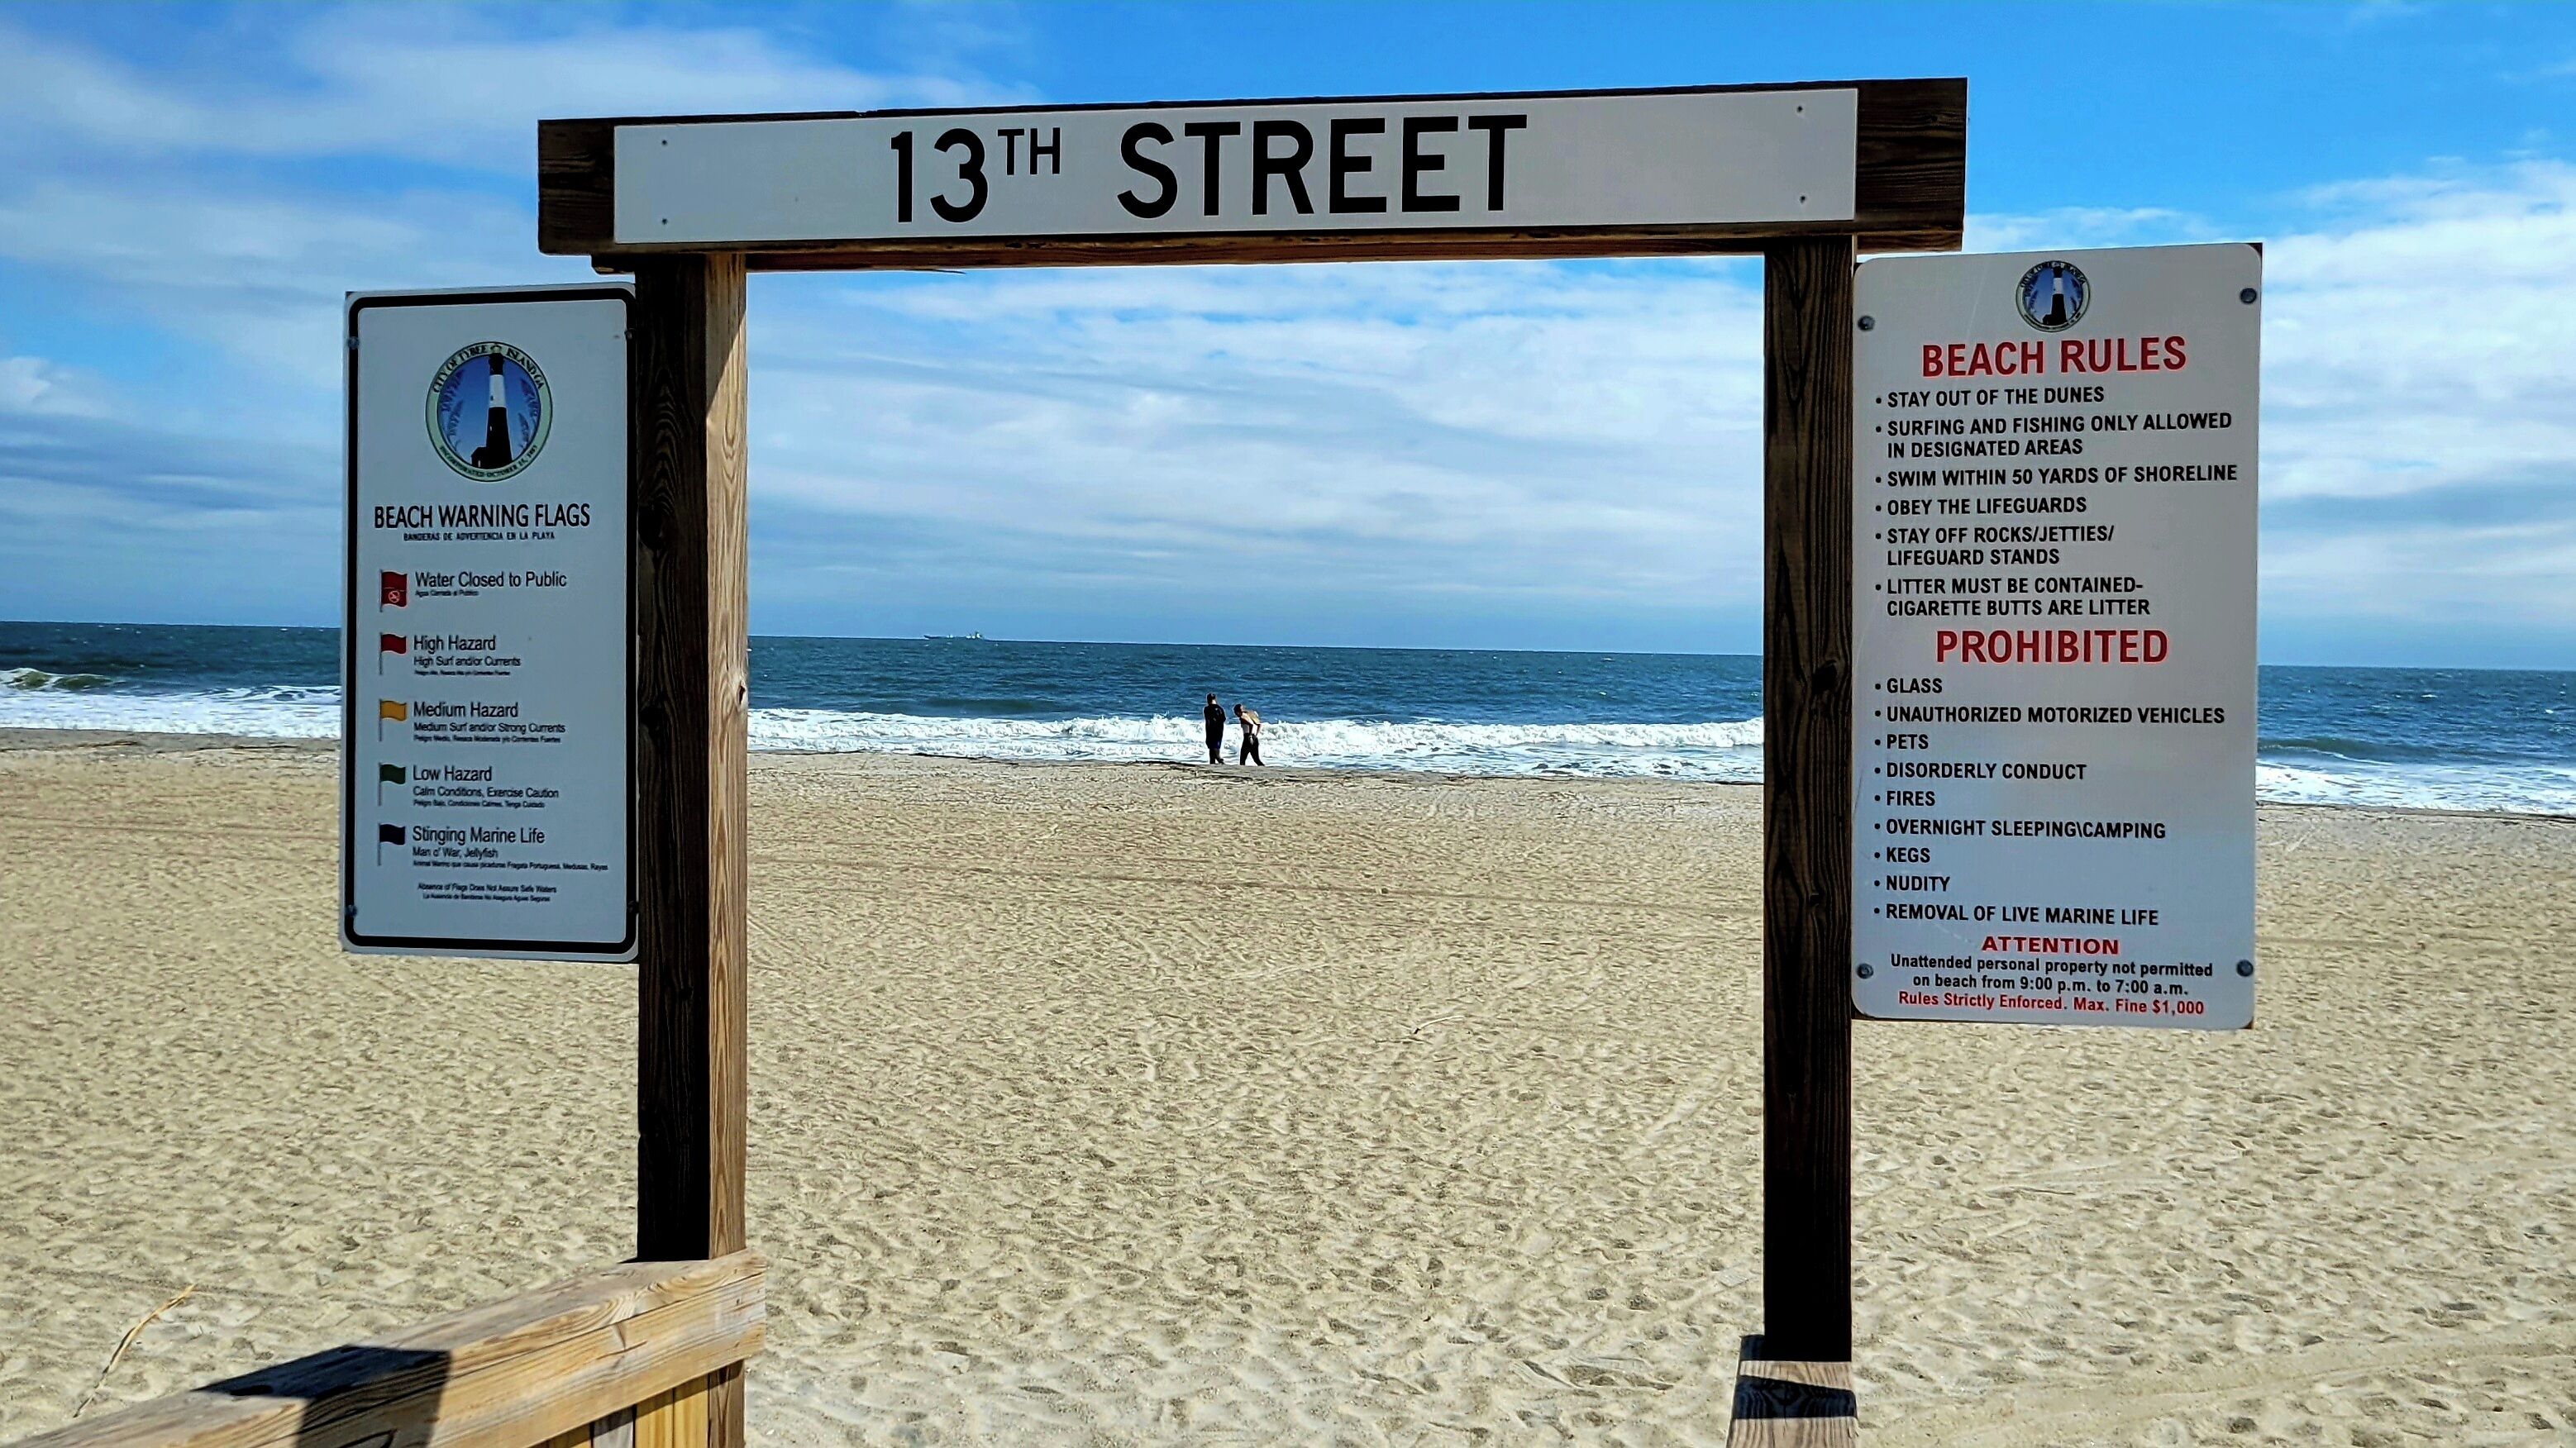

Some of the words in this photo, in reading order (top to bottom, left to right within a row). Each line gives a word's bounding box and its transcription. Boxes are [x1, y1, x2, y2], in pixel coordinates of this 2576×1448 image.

[890, 127, 1060, 223] 13TH
[1117, 114, 1528, 219] STREET
[1923, 341, 2044, 377] BEACH
[2060, 336, 2186, 373] RULES
[1887, 391, 1930, 408] STAY
[1935, 390, 1971, 407] OUT
[1976, 389, 1999, 405] OF
[2004, 388, 2038, 405] THE
[2044, 386, 2104, 403] DUNES
[1887, 419, 1964, 436] SURFING
[1969, 418, 2006, 435] AND
[2013, 416, 2084, 433] FISHING
[2091, 414, 2138, 431] ONLY
[2142, 412, 2231, 431] ALLOWED
[1887, 442, 1904, 459] IN
[1911, 440, 2020, 458] DESIGNATED
[2024, 438, 2082, 455] AREAS
[1887, 470, 1936, 487] SWIM
[1942, 469, 2006, 486] WITHIN
[2011, 469, 2032, 484] 50
[2038, 467, 2098, 484] YARDS
[2105, 466, 2127, 483] OF
[2134, 464, 2237, 483] SHORELINE
[1887, 499, 1932, 516] OBEY
[1937, 498, 1970, 515] THE
[1977, 497, 2087, 514] LIFEGUARDS
[374, 505, 432, 529] BEACH
[438, 504, 528, 527] WARNING
[535, 503, 590, 527] FLAGS
[519, 531, 528, 541] LA
[532, 531, 555, 540] PLAYA
[1887, 527, 1930, 544] STAY
[1935, 527, 1968, 544] OFF
[1887, 549, 1984, 566] LIFEGUARD
[1990, 548, 2059, 565] STANDS
[415, 571, 456, 588] Water
[458, 571, 504, 588] Closed
[508, 572, 521, 587] to
[525, 570, 566, 587] Public
[1887, 579, 1945, 594] LITTER
[1951, 578, 2001, 594] MUST
[2007, 578, 2028, 593] BE
[1887, 600, 1981, 617] CIGARETTE
[1987, 599, 2042, 616] BUTTS
[2047, 599, 2082, 615] ARE
[2089, 598, 2150, 615] LITTER
[413, 635, 444, 655] High
[448, 635, 496, 651] Hazard
[1937, 630, 2168, 663] PROHIBITED
[413, 656, 433, 669] High
[436, 655, 454, 666] Surf
[1887, 678, 1942, 693] GLASS
[413, 701, 466, 717] Medium
[470, 702, 518, 717] Hazard
[1887, 706, 2021, 722] UNAUTHORIZED
[2028, 707, 2132, 723] MOTORIZED
[2137, 707, 2225, 724] VEHICLES
[413, 722, 447, 732] Medium
[449, 722, 468, 732] Surf
[498, 722, 527, 736] Strong
[1887, 734, 1929, 750] PETS
[413, 765, 441, 781] Low
[444, 765, 492, 782] Hazard
[1887, 762, 1996, 779] DISORDERLY
[2002, 763, 2087, 780] CONDUCT
[413, 786, 435, 797] Calm
[486, 787, 523, 798] Exercise
[525, 787, 559, 798] Caution
[1887, 790, 1935, 807] FIRES
[412, 825, 465, 845] Stinging
[470, 826, 516, 843] Marine
[520, 827, 545, 844] Life
[1886, 818, 1986, 836] OVERNIGHT
[412, 847, 432, 856] Man
[464, 848, 498, 860] Jellyfish
[1887, 846, 1930, 863] KEGS
[1886, 874, 1950, 892] NUDITY
[1886, 903, 1968, 921] REMOVAL
[1973, 905, 1996, 922] OF
[2002, 906, 2039, 922] LIVE
[2045, 907, 2115, 925] MARINE
[2121, 909, 2159, 926] LIFE
[1981, 936, 2118, 955] ATTENTION
[1891, 953, 1972, 969] Unattended
[1977, 958, 2039, 973] personal
[2045, 960, 2108, 977] property
[2112, 961, 2135, 974] not
[2140, 962, 2212, 978] permitted
[1913, 976, 1930, 987] on
[1934, 973, 1977, 988] beach
[1981, 974, 2015, 989] from
[2020, 976, 2052, 990] 9:00
[2058, 980, 2091, 994] p.m.
[2097, 979, 2111, 993] to
[2115, 979, 2149, 993] 7:00
[2153, 984, 2187, 995] a.m.
[1899, 991, 1939, 1005] Rules
[1944, 992, 1995, 1010] Strictly
[1999, 994, 2067, 1010] Enforced.
[2073, 997, 2109, 1012] Max.
[2116, 998, 2147, 1012] Fine
[2151, 999, 2204, 1016] $1,000
